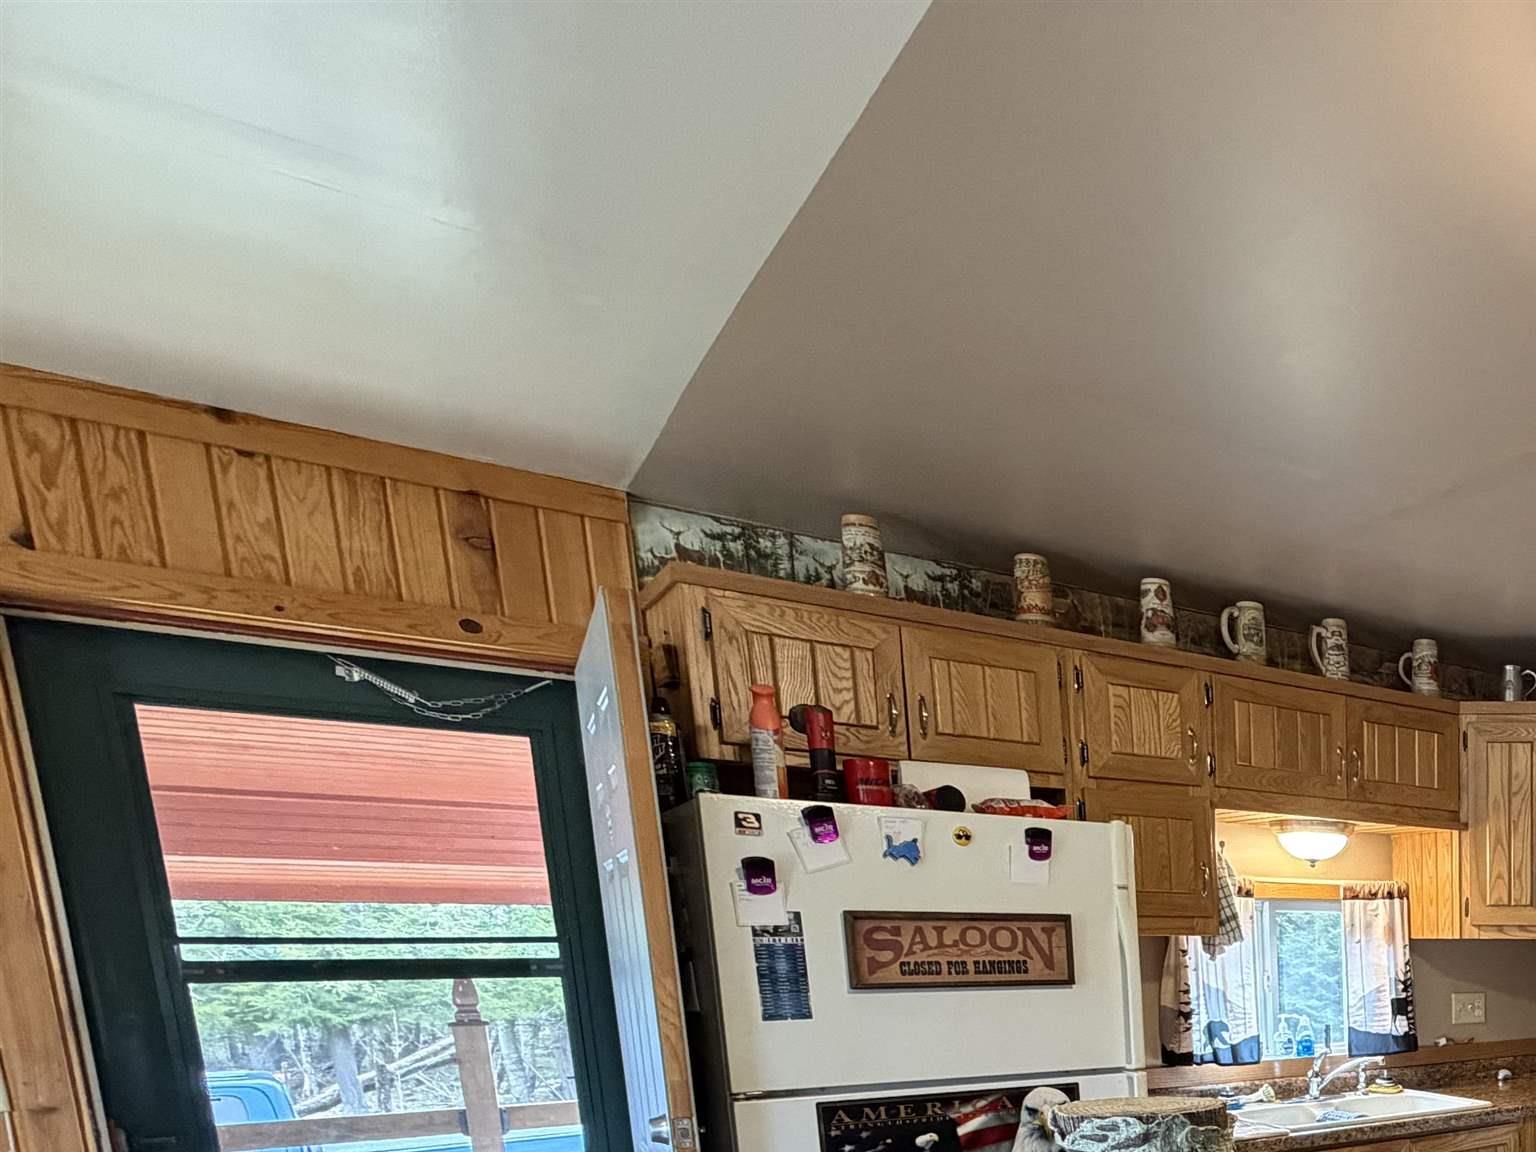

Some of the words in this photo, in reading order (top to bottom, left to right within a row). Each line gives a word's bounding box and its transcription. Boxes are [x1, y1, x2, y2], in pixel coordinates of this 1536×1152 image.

[737, 812, 760, 829] 3
[862, 925, 1058, 977] SALOON
[899, 960, 943, 977] CLOSED
[947, 960, 970, 976] FOR
[973, 959, 1029, 976] HANGINGS
[831, 1095, 1014, 1126] AMERICA
